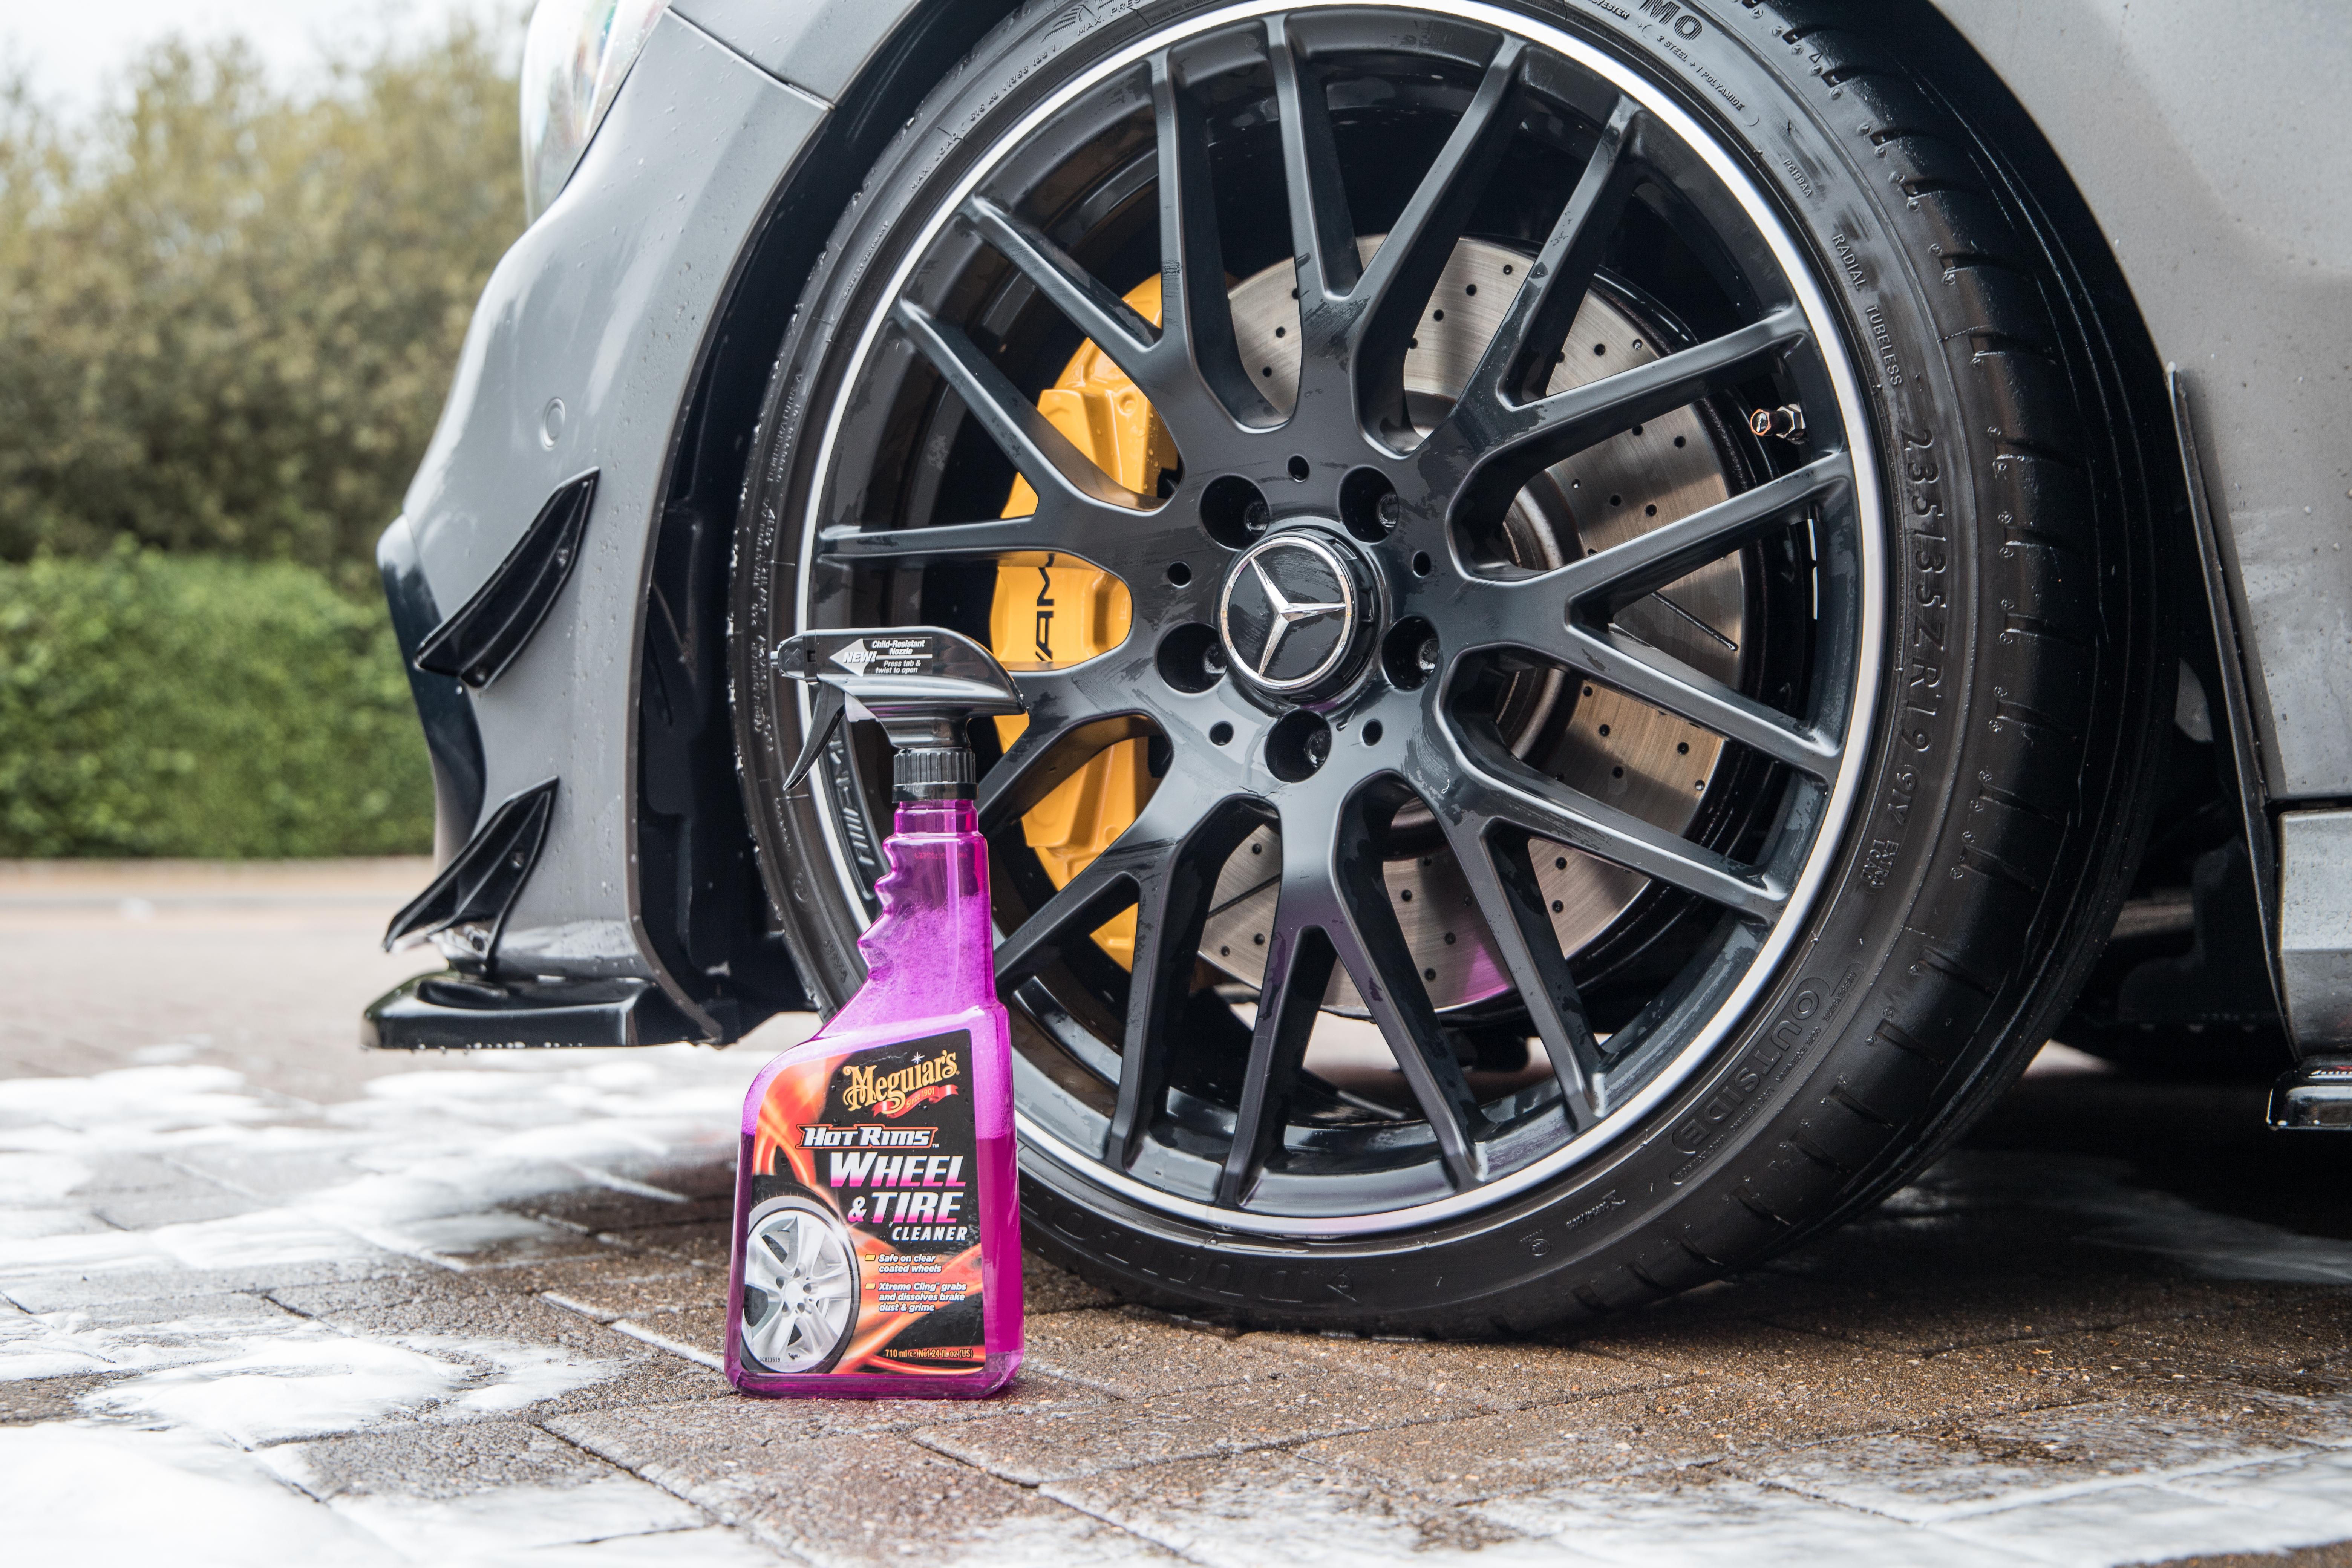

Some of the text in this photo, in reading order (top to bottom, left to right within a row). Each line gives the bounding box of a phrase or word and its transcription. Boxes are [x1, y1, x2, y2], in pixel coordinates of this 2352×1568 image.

[1077, 15, 1105, 36] MAX.
[1639, 0, 1702, 41] MO
[1663, 38, 1689, 62] STEEL
[1700, 67, 1745, 113] POLYAMIDE
[908, 130, 960, 192] MAX. LOAD
[1782, 156, 1813, 199] PC199AA
[862, 219, 890, 262] GERMANY
[1831, 231, 1903, 389] RADIAL TUBELESS
[766, 386, 798, 482] TEMPERATURE
[843, 651, 877, 663] NEW!
[872, 640, 925, 648] Child-Resistant
[1870, 840, 1899, 888] EXTRA
[1680, 990, 1819, 1142] OUTSIDE
[906, 1087, 934, 1109] Since 1901
[831, 1152, 966, 1187] WHEEL
[848, 1192, 964, 1223] & TIRE
[891, 1226, 968, 1241] CLEANER
[879, 1254, 899, 1262] Safe
[913, 1254, 936, 1263] clear
[879, 1264, 942, 1273] coated wheels
[878, 1282, 911, 1291] Xtreme
[941, 1282, 967, 1292] grabs
[879, 1292, 965, 1302] and dissolves brake
[879, 1303, 935, 1313] dust & grime
[885, 1349, 898, 1358] 710
[899, 1349, 907, 1358] ml
[918, 1349, 930, 1358] Net
[931, 1349, 940, 1358] 24
[959, 1348, 974, 1359] (US)
